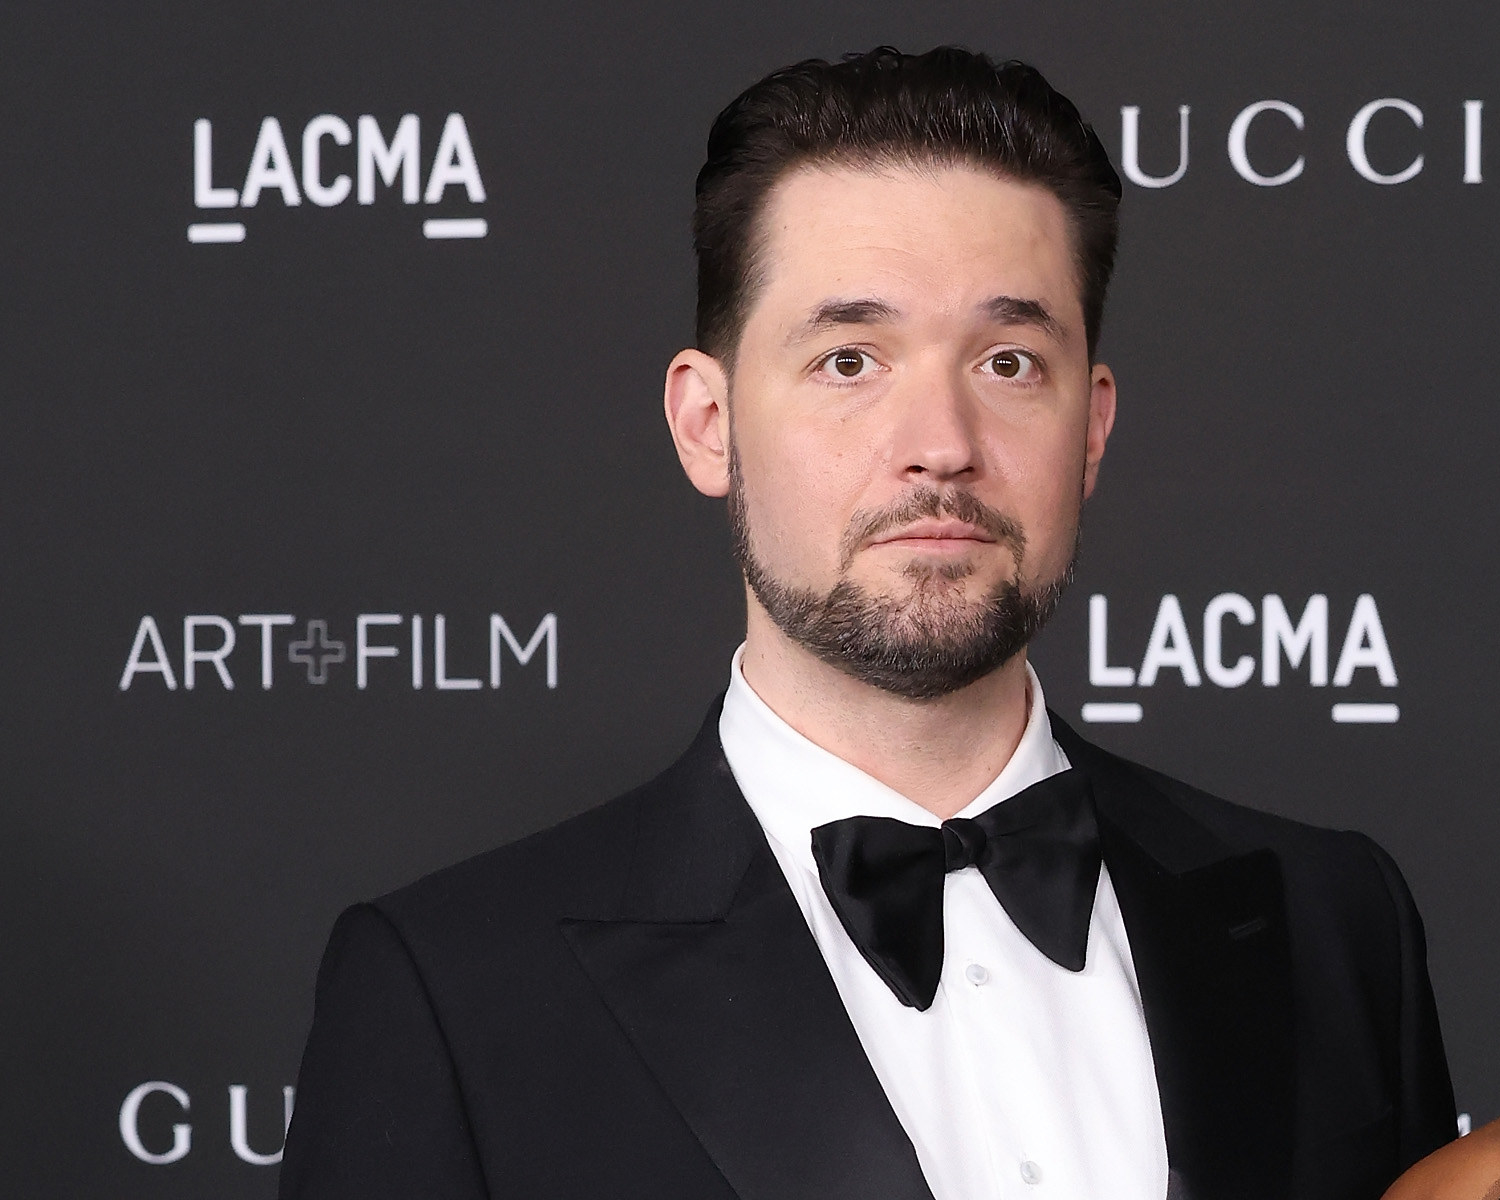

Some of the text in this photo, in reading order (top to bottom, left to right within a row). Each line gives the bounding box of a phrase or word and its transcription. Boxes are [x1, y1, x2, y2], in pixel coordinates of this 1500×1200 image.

[193, 112, 487, 209] LACMA
[1120, 98, 1484, 188] UCCI
[119, 612, 558, 691] ART+FILM
[1088, 592, 1399, 689] LACMA
